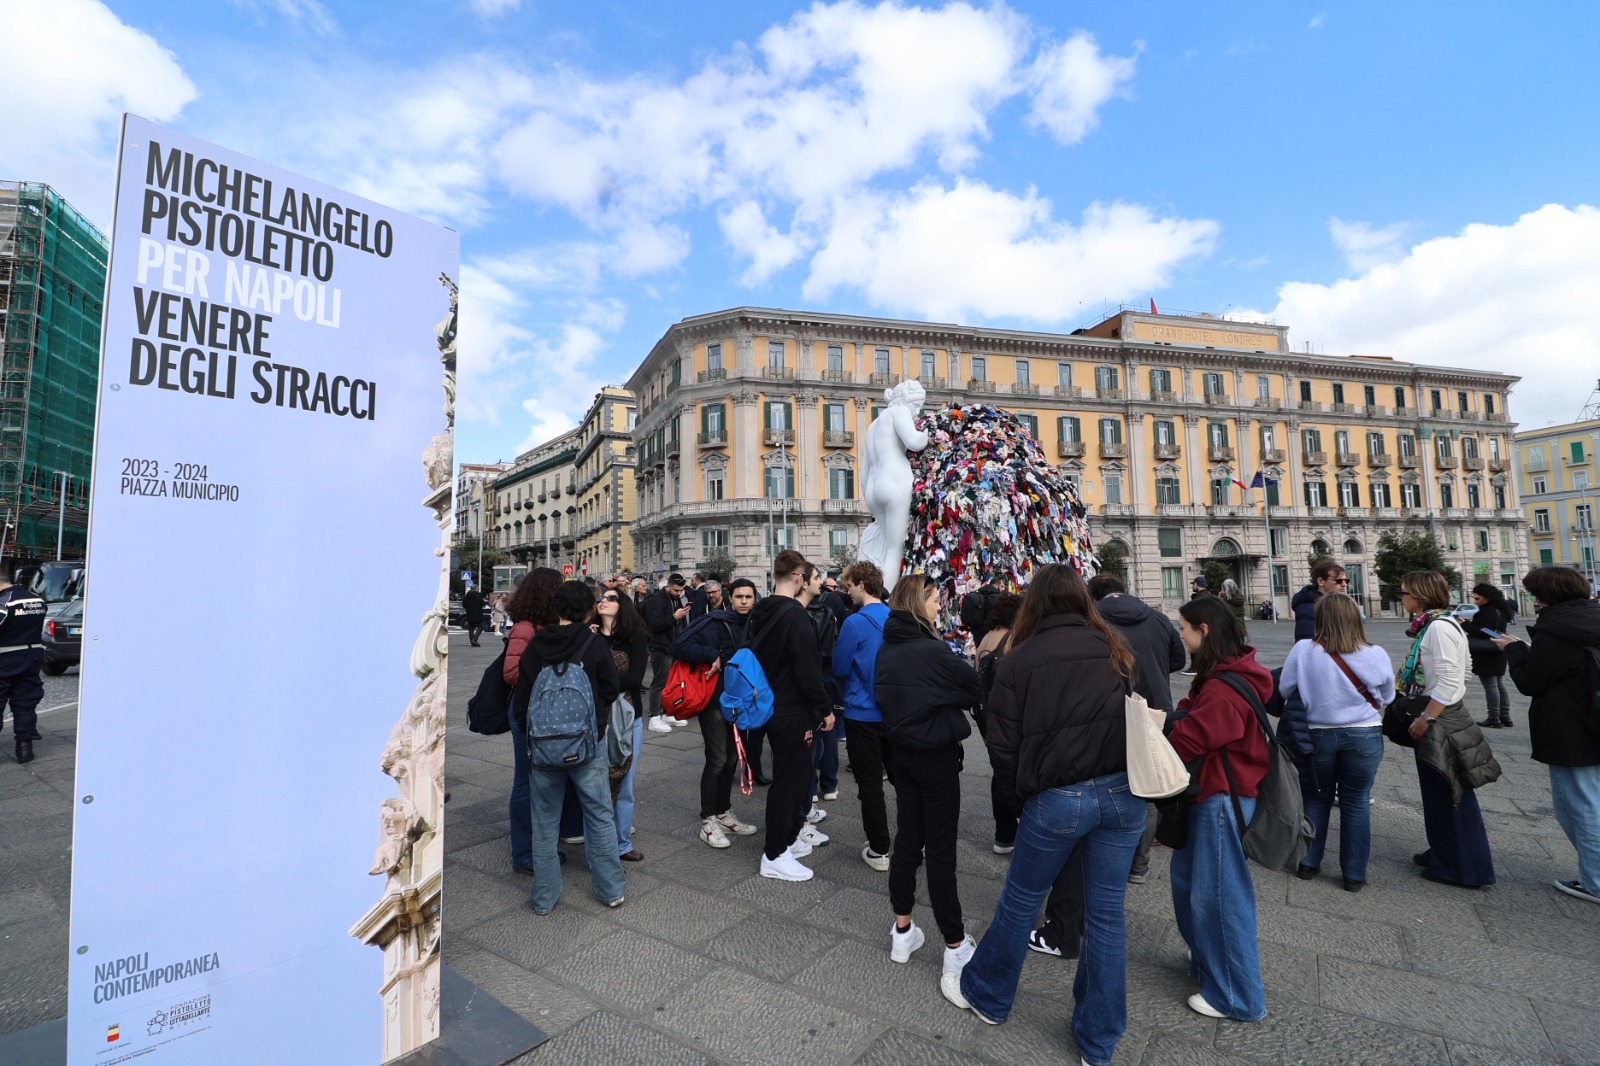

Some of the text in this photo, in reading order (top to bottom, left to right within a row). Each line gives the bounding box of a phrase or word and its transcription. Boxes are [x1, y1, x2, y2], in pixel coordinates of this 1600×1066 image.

[146, 140, 393, 258] MICHELANGELO
[141, 188, 334, 282] PISTOLETTO
[137, 237, 342, 328] PER NAPOLI
[133, 286, 273, 358] VENERE
[1151, 326, 1263, 346] GRAND HOTEL LONDRES
[129, 337, 377, 421] DEGLI STRACCI
[121, 458, 159, 478] 2023
[174, 463, 208, 482] 2024
[121, 477, 240, 502] PIAZZA MUNICIPIO
[93, 952, 220, 1004] CONTEMPORANEA
[94, 952, 149, 984] NAPOLI
[170, 998, 212, 1017] PISTOLETTO
